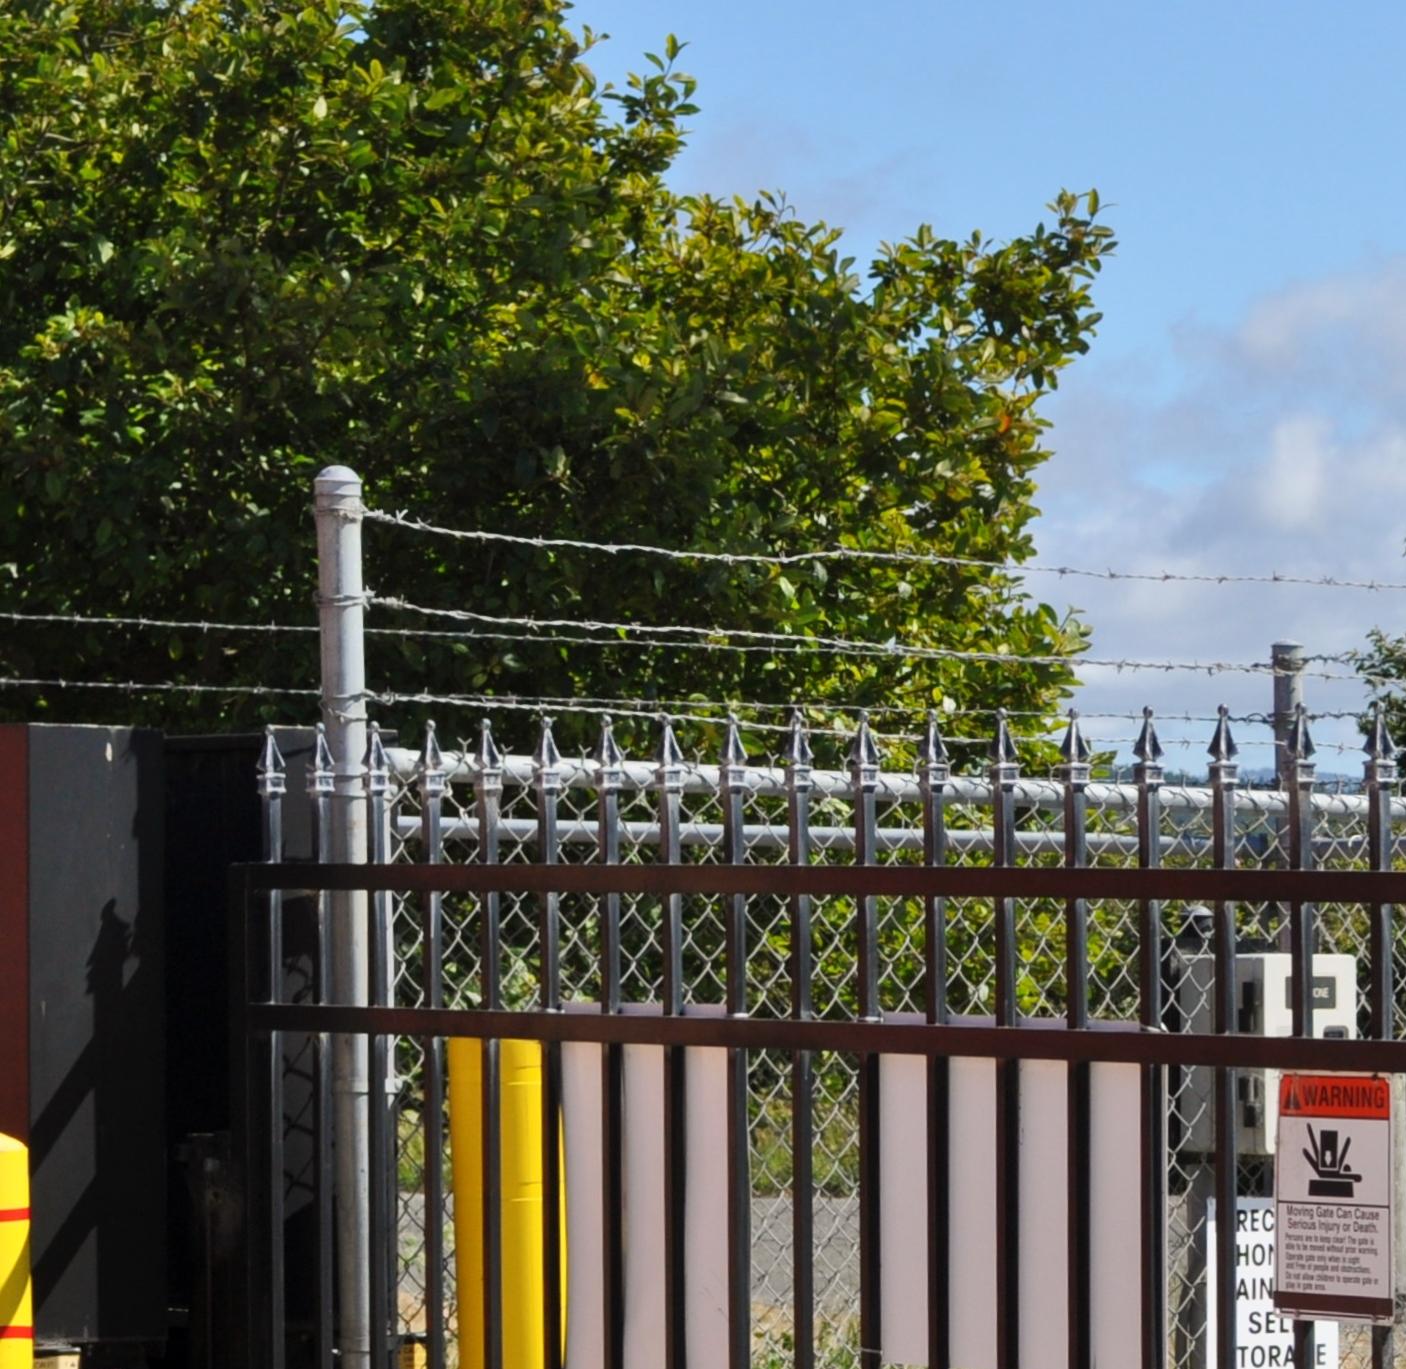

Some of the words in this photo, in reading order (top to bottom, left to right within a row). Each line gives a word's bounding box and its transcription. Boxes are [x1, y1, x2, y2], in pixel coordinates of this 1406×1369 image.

[1303, 1085, 1384, 1109] WARNING
[1236, 1209, 1274, 1232] REC
[1287, 1205, 1314, 1219] Moving
[1316, 1206, 1334, 1218] Gate
[1336, 1207, 1352, 1219] Can
[1354, 1208, 1379, 1220] Cause
[1288, 1218, 1316, 1230] Serious
[1319, 1220, 1340, 1233] Injury
[1342, 1223, 1350, 1232] or
[1248, 1311, 1294, 1335] SEL
[1236, 1343, 1326, 1368] TORAE
